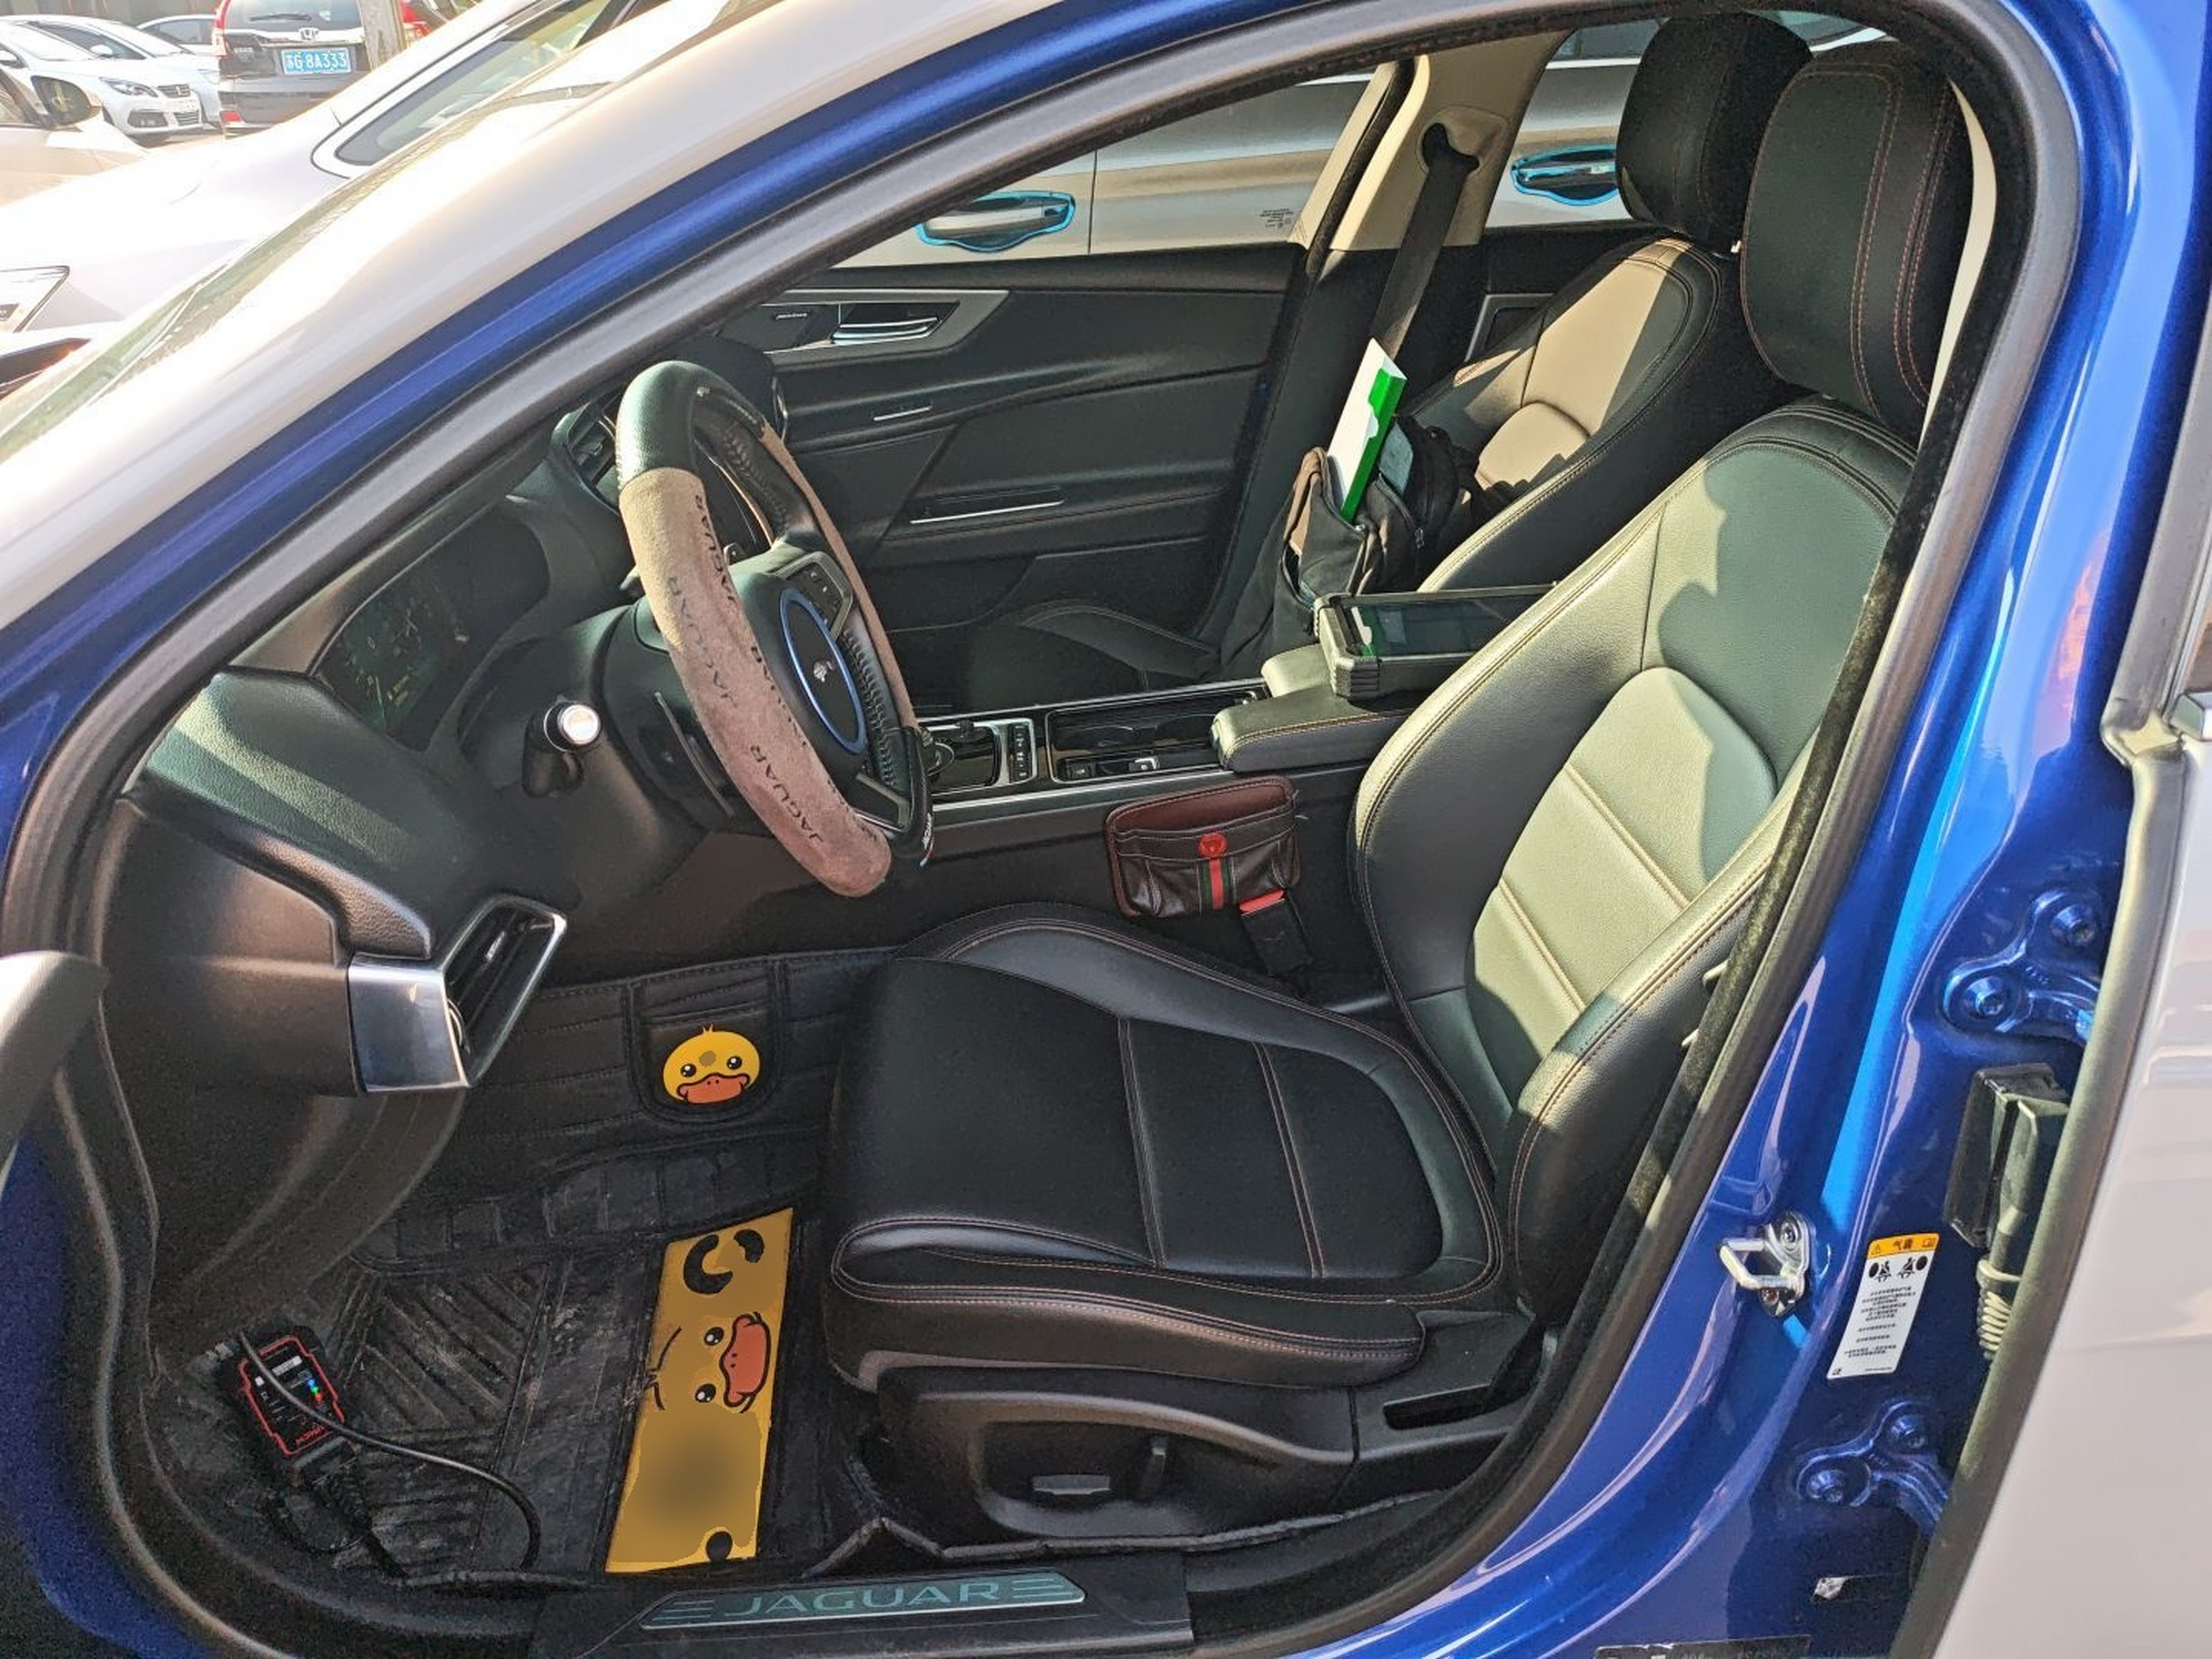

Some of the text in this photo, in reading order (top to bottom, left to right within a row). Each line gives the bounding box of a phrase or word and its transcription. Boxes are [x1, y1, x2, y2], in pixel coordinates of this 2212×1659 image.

[668, 577, 738, 707] JAGUAR
[750, 745, 824, 843] JAGUAR
[724, 1582, 1000, 1617] JAGUAR
